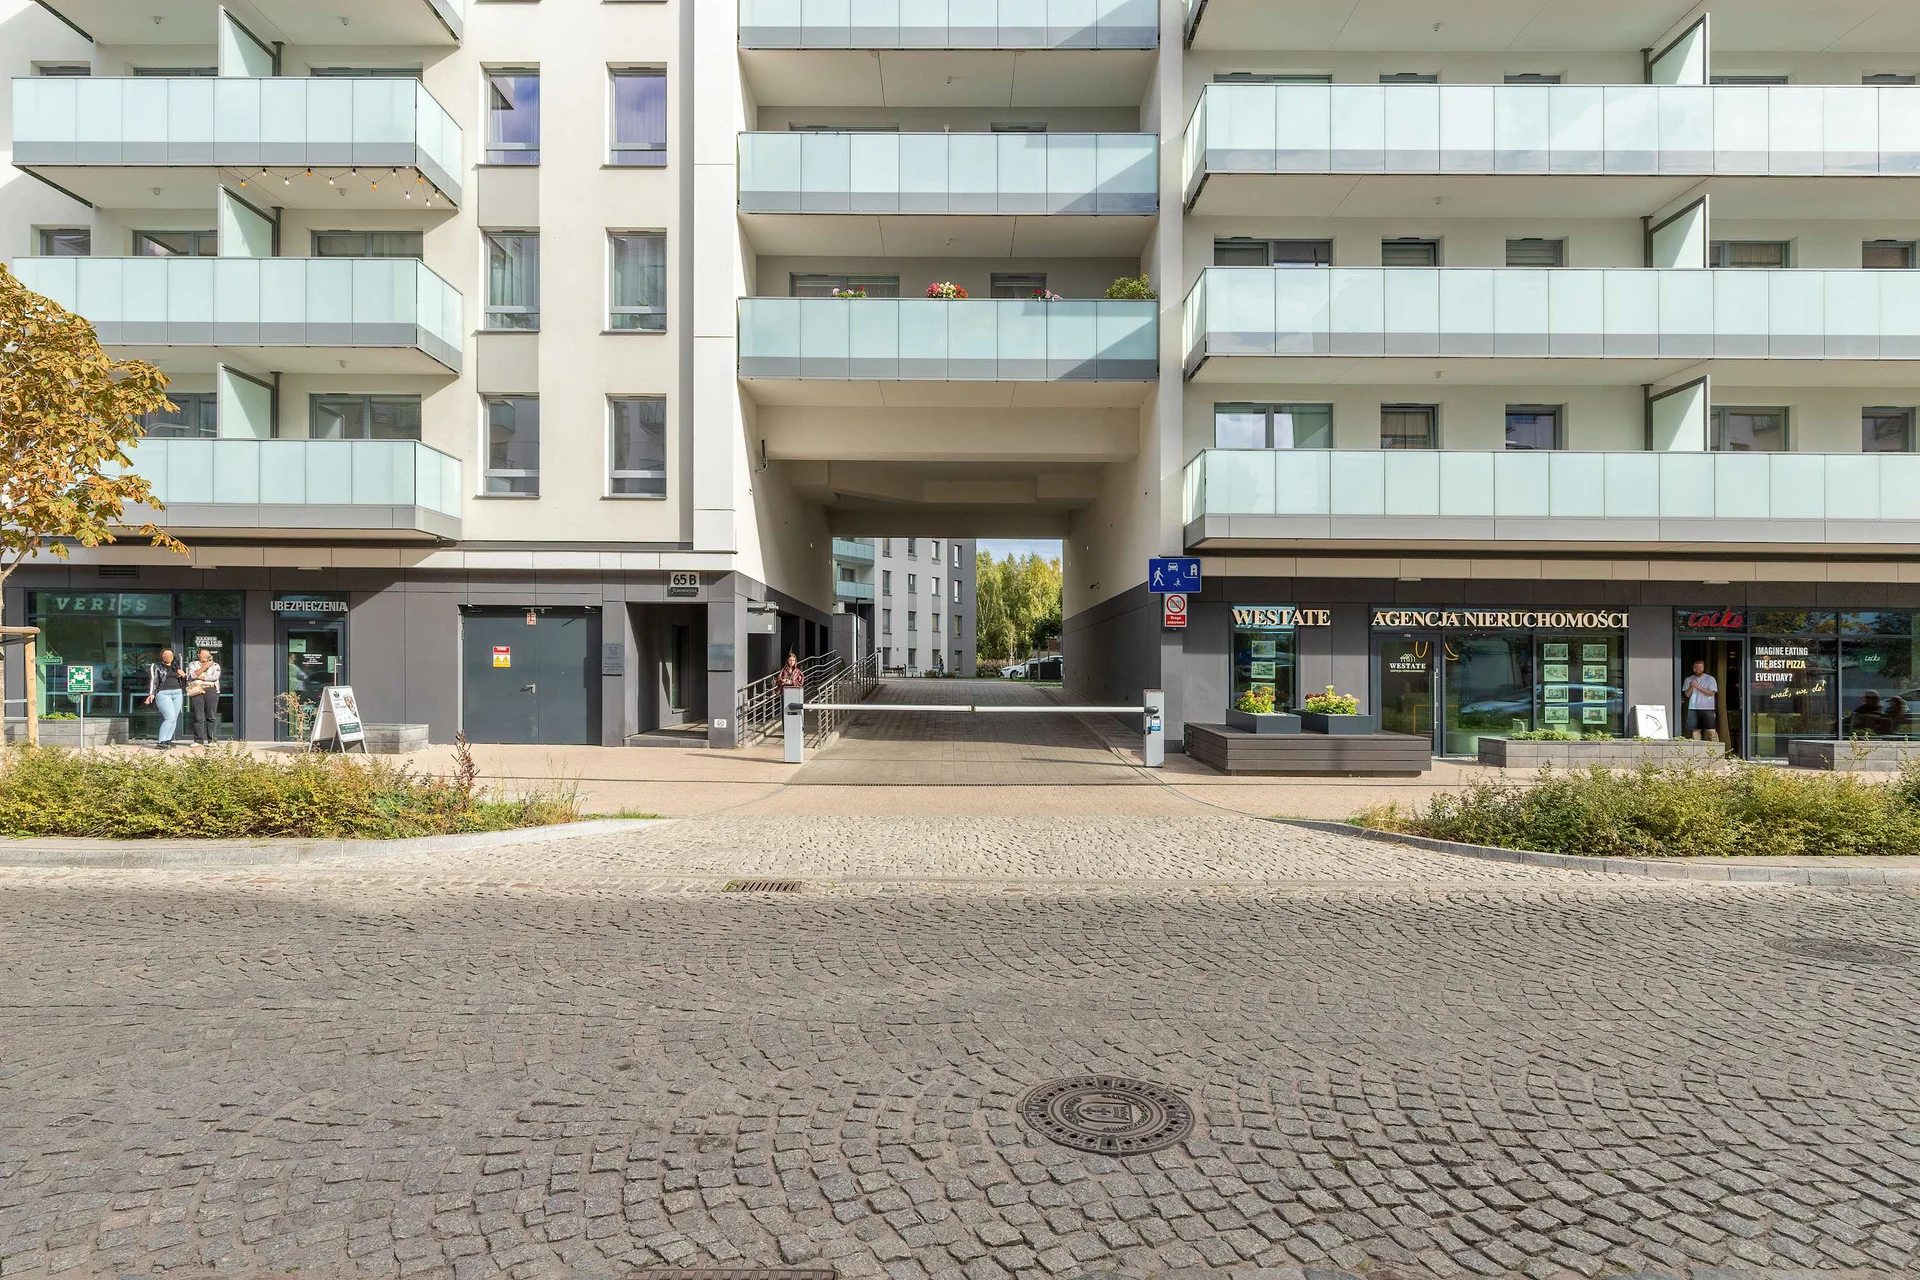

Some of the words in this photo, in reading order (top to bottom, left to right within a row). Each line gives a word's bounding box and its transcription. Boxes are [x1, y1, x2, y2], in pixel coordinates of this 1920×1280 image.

[673, 574, 687, 585] 65
[689, 574, 697, 585] B
[56, 597, 148, 611] VERISS
[270, 601, 349, 612] UBEZPIECZENIA
[1231, 609, 1331, 626] WESTATE
[1371, 611, 1460, 627] AGENCJA
[1463, 609, 1629, 628] NIERUCHOMOŚCI
[1755, 646, 1784, 656] IMAGINE
[1785, 646, 1809, 656] EATING
[1755, 660, 1769, 669] THE
[1769, 660, 1786, 669] BEST
[1786, 660, 1806, 669] PIZZA
[1755, 672, 1793, 682] EVERYDAY?
[1795, 687, 1808, 695] we
[1811, 679, 1827, 693] do!
